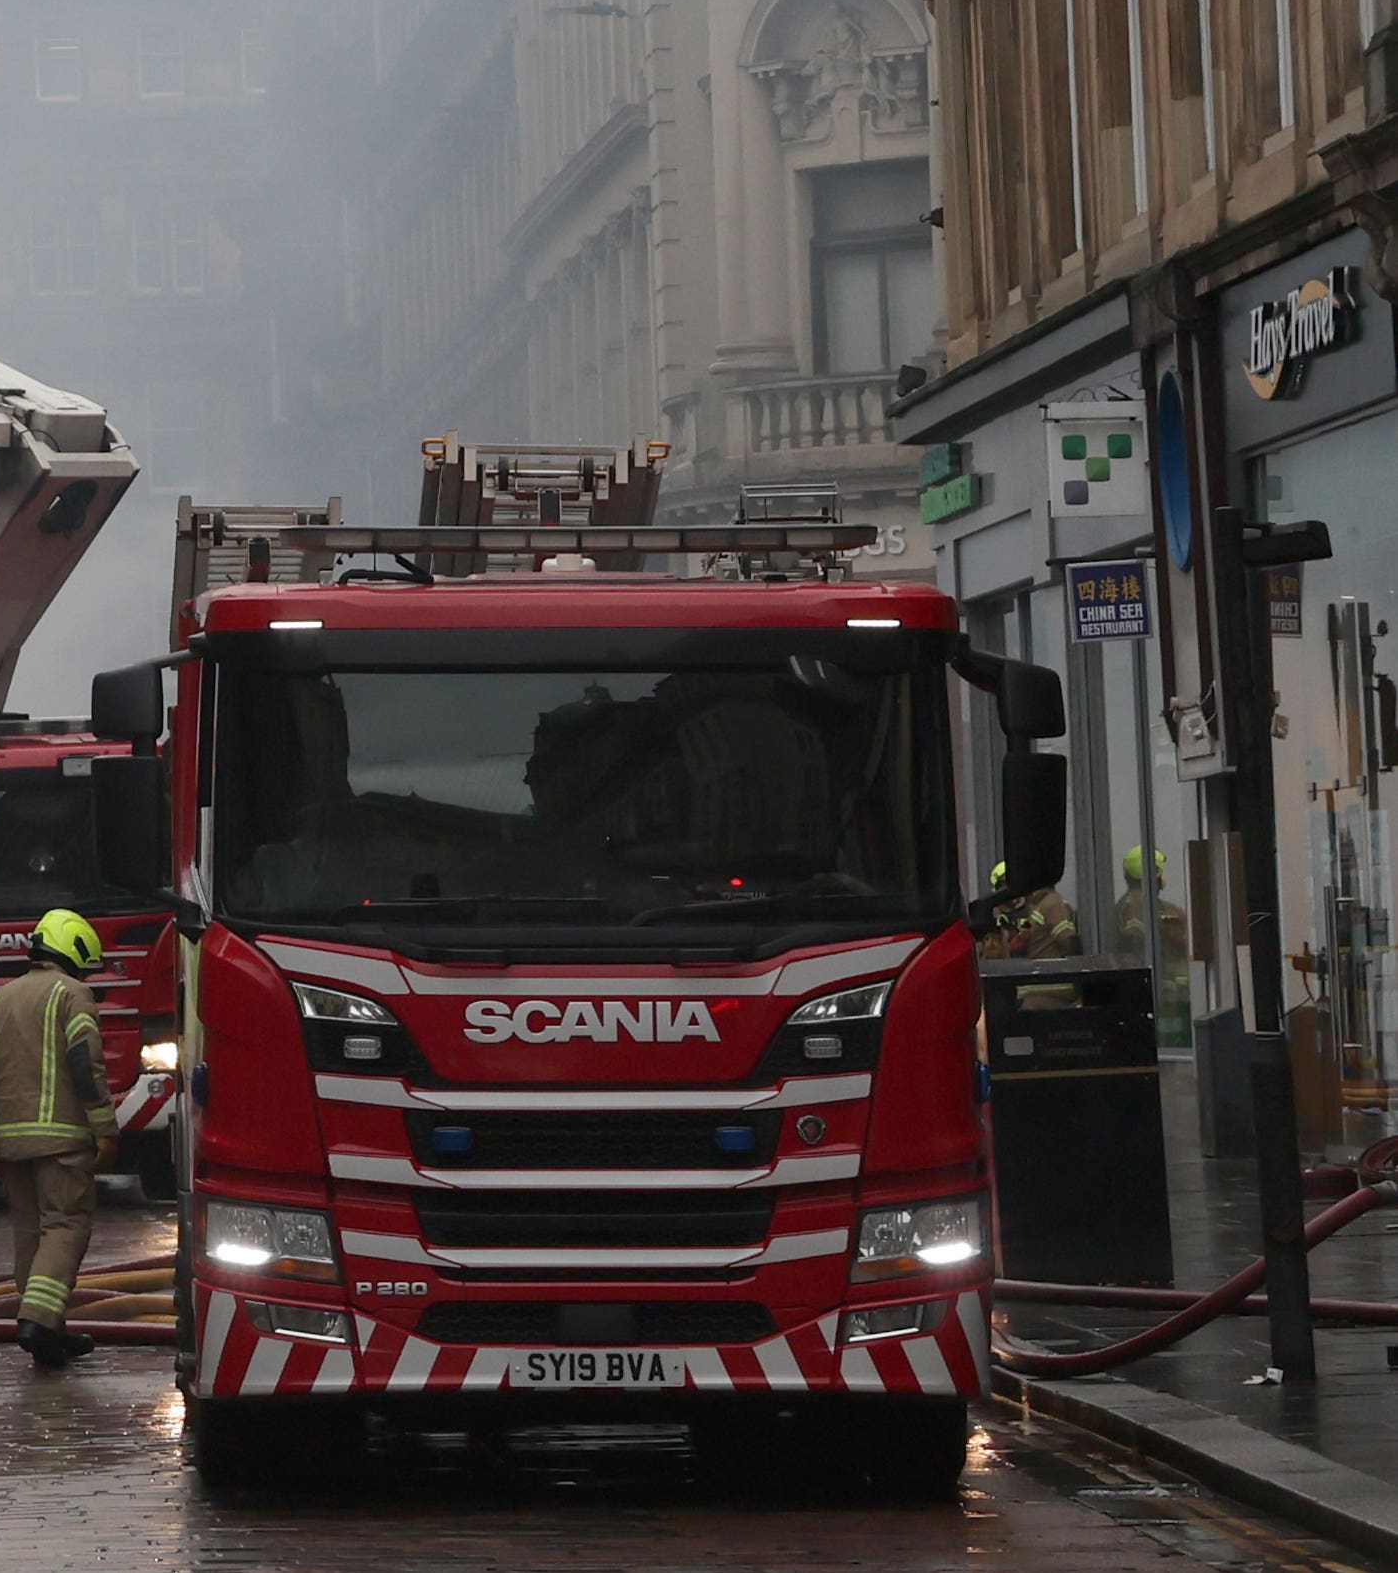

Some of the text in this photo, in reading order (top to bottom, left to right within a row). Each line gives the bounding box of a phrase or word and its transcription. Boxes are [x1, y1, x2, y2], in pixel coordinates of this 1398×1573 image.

[1250, 270, 1335, 384] Hays Travel
[1079, 603, 1143, 622] CHINA SEA
[1081, 620, 1144, 636] RESTAURANT
[463, 1000, 721, 1045] SCANIA
[355, 1281, 428, 1296] P 280
[528, 1352, 666, 1382] SY19 BVA
